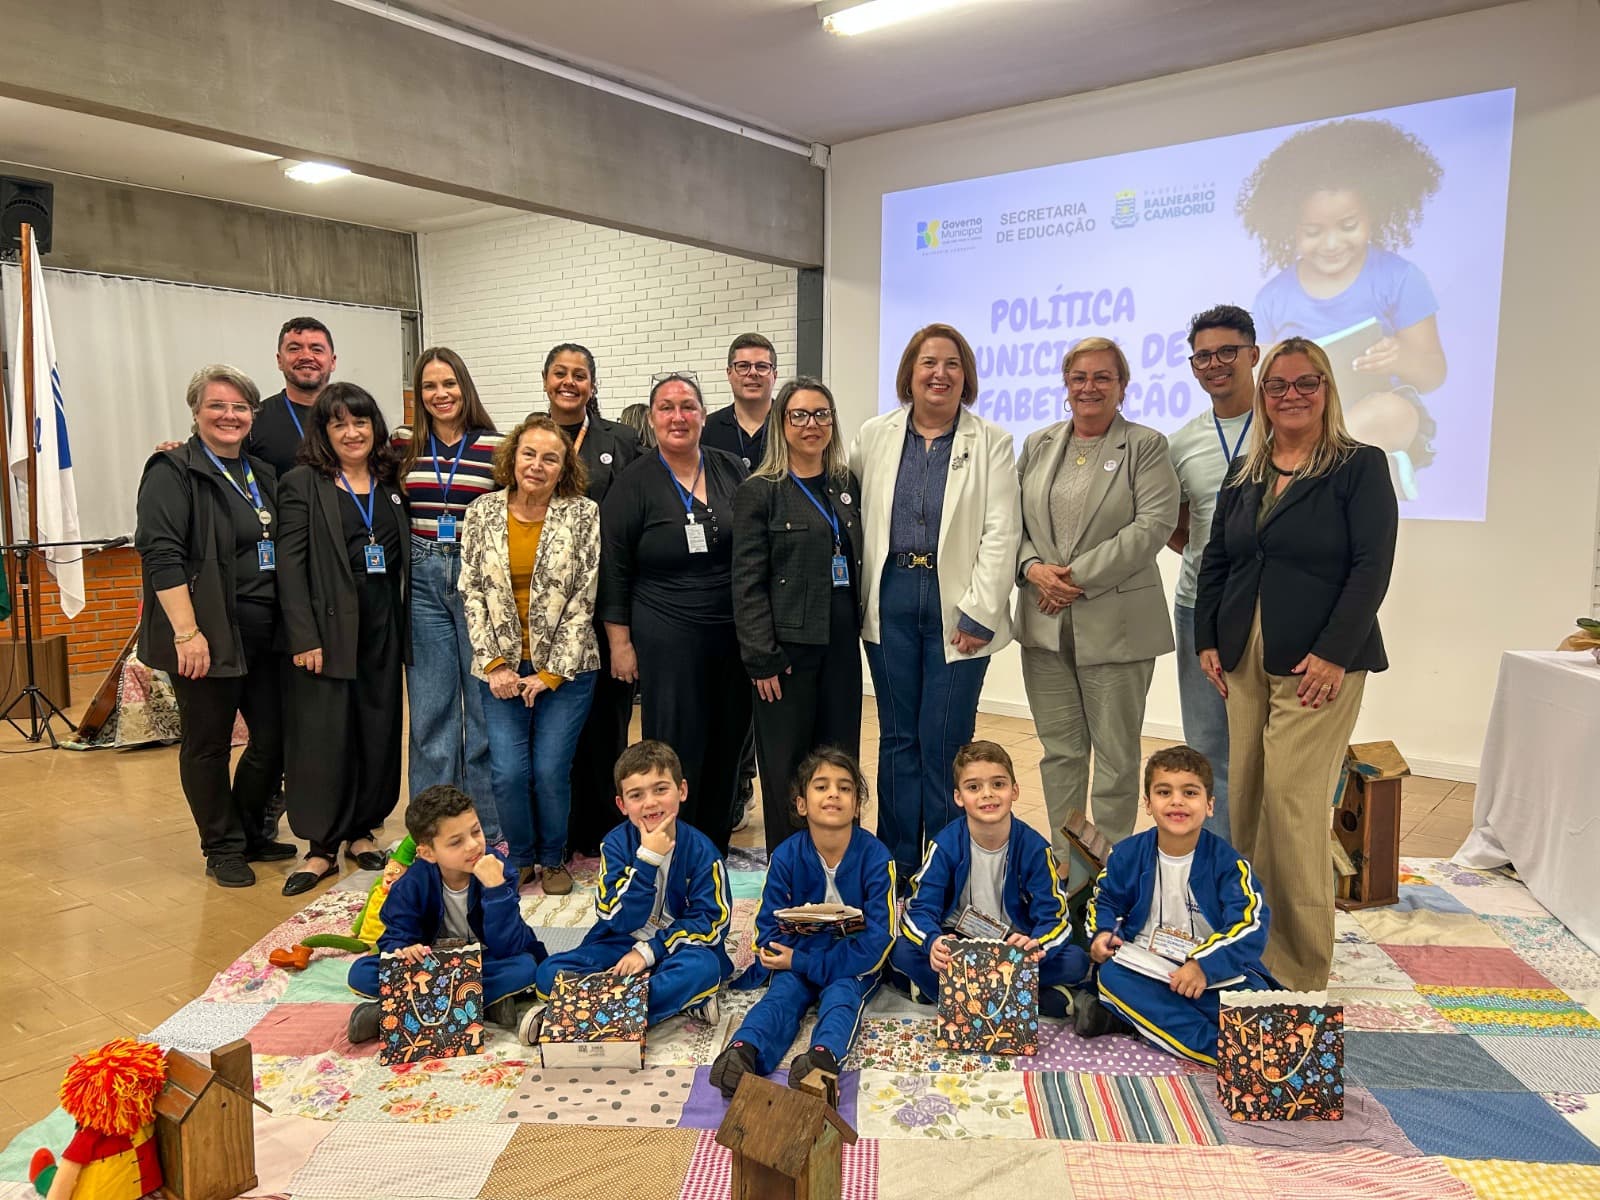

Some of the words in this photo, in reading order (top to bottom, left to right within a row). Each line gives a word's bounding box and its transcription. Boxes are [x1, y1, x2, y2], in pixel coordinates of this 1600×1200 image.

[942, 217, 982, 229] Governo
[1000, 202, 1087, 226] SECRETARIA
[941, 225, 983, 239] Municipal
[996, 230, 1015, 243] DE
[1018, 216, 1096, 241] EDUCAÇÃO
[991, 284, 1136, 334] POLÍTICA
[1141, 330, 1187, 370] DE
